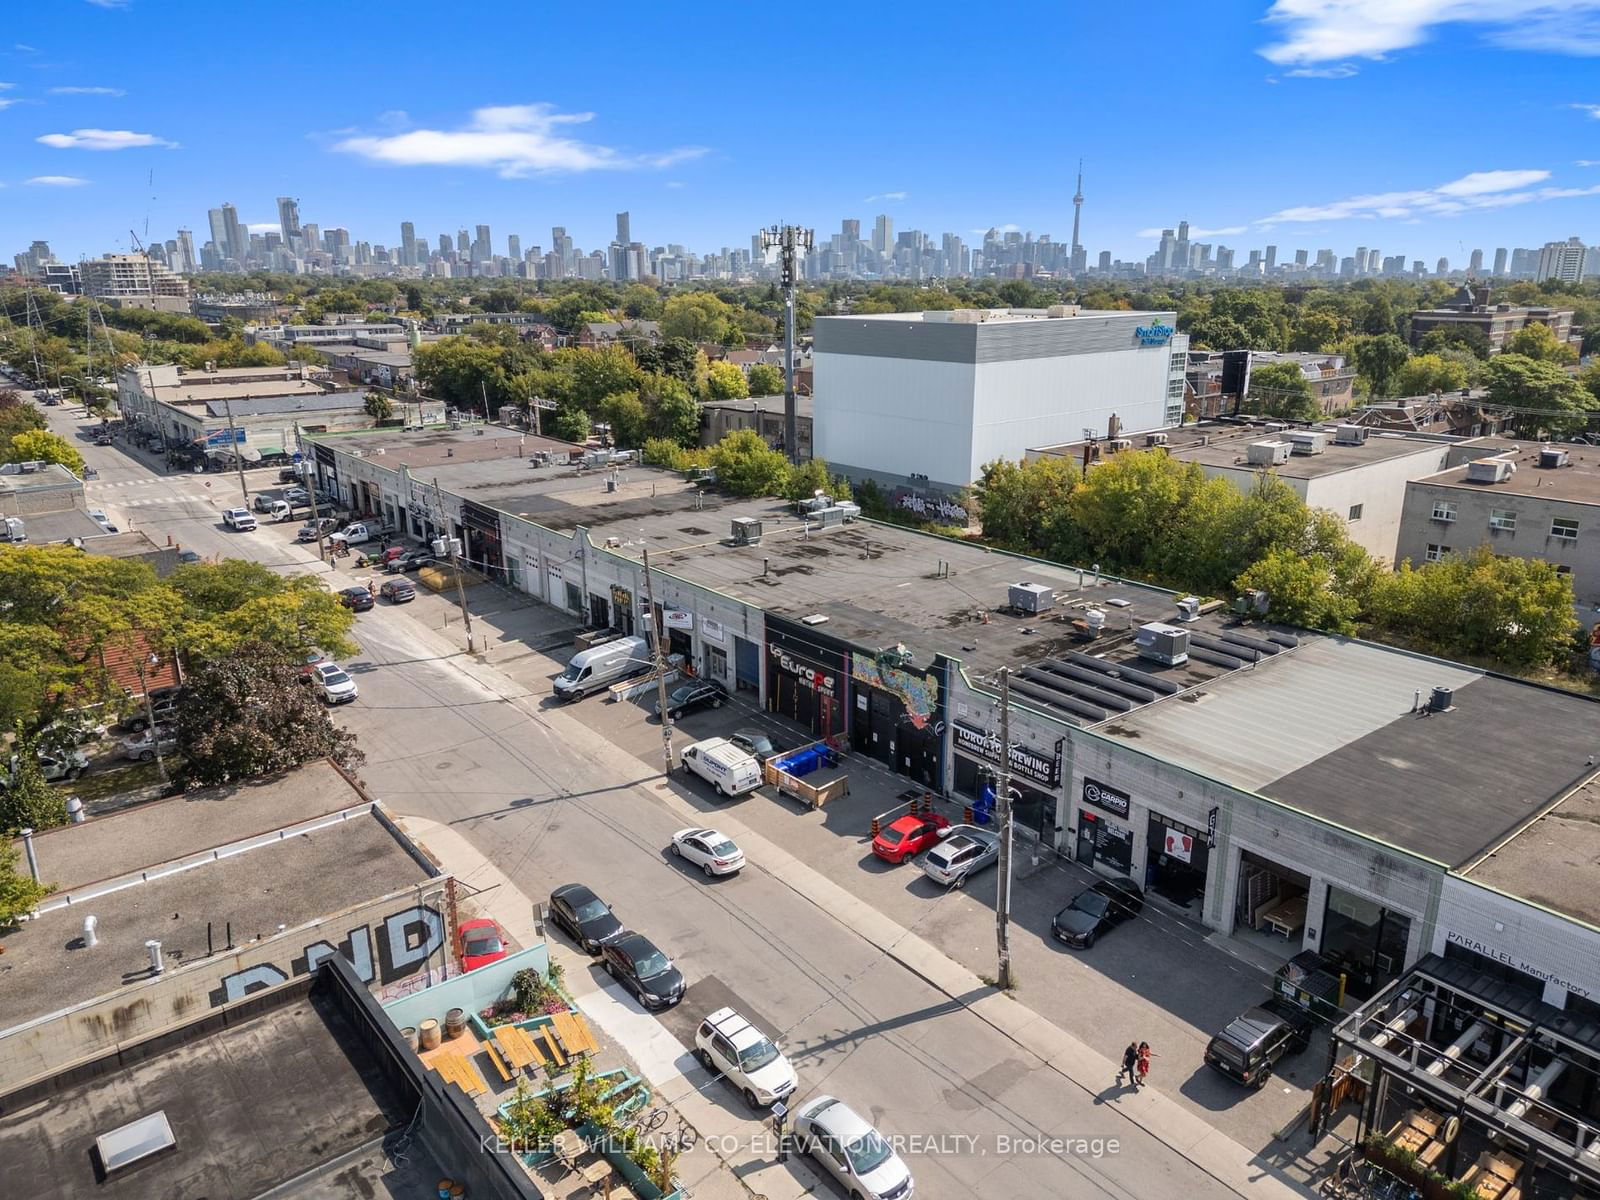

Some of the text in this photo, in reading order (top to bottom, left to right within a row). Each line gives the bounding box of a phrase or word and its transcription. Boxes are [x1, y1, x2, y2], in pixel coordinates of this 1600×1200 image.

[1100, 792, 1127, 808] CARPIO
[1447, 930, 1591, 998] PARALLEL Manufactory
